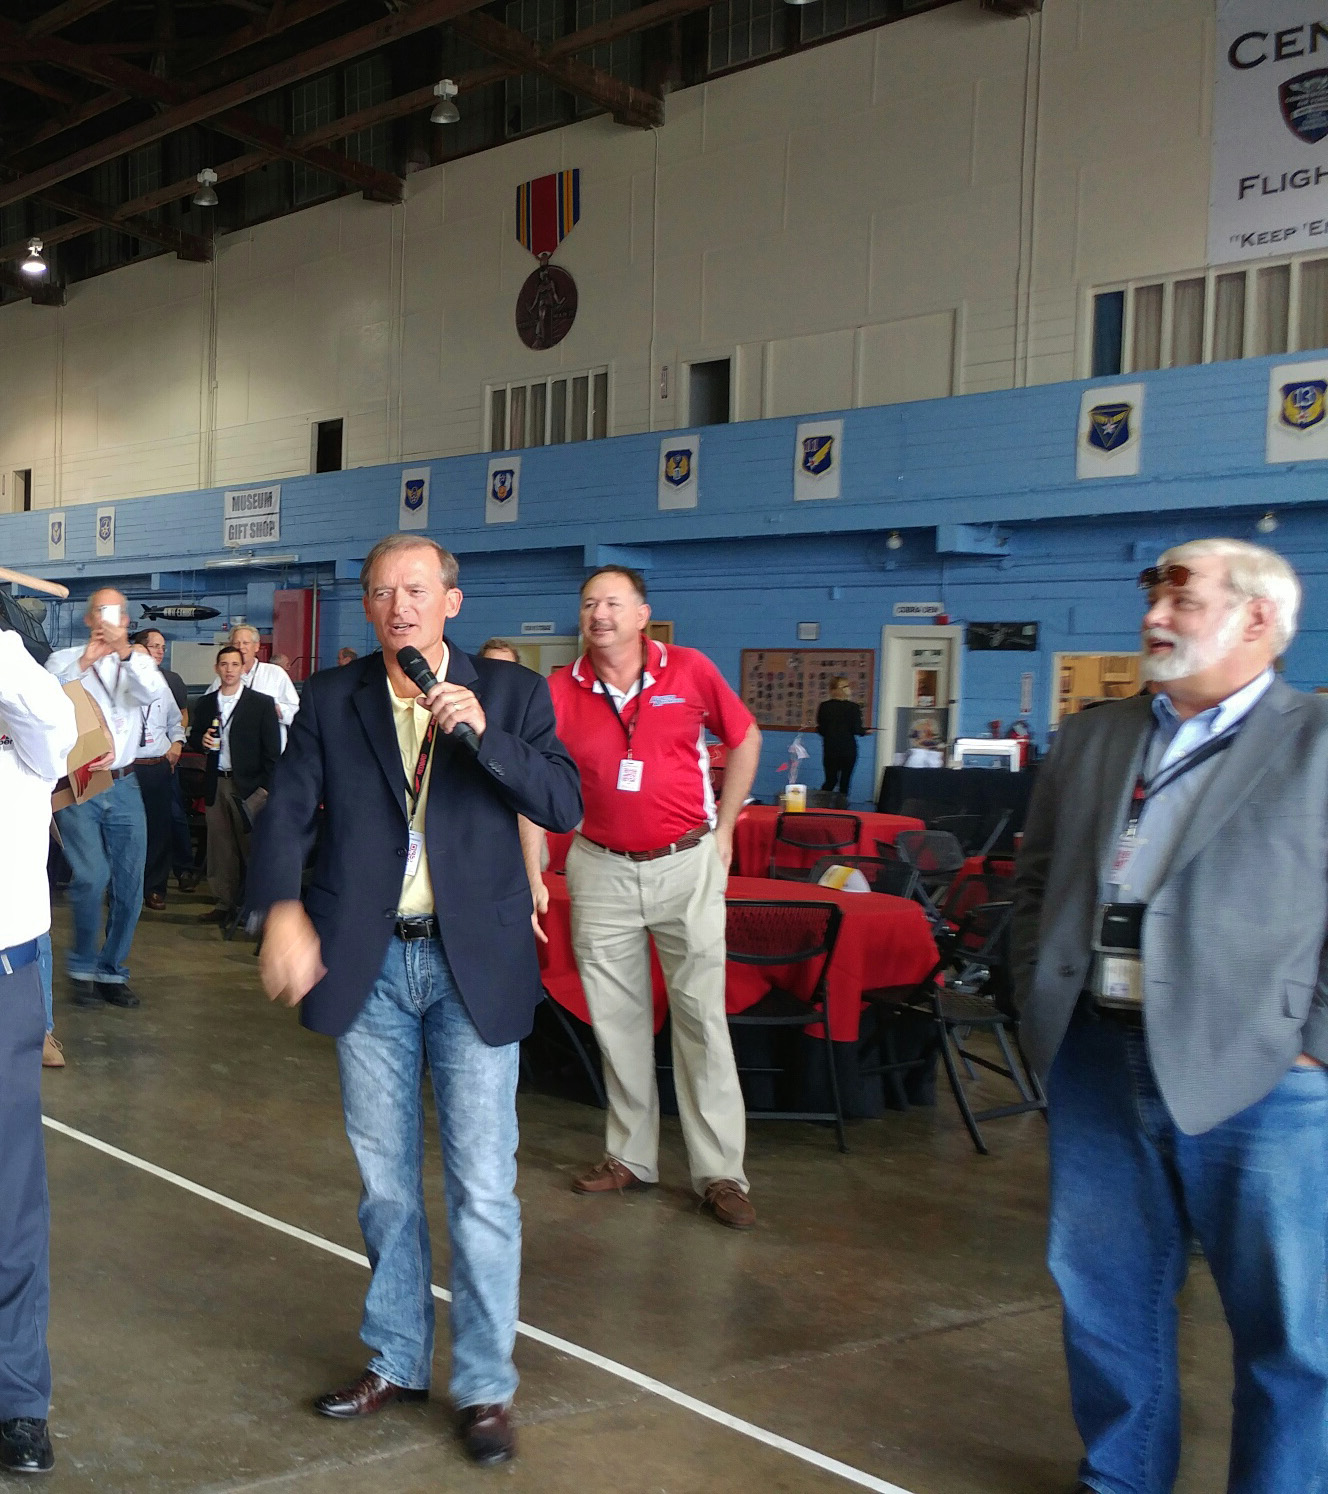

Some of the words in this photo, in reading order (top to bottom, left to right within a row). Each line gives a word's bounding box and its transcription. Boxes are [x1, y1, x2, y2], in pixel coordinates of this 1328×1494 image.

[1295, 386, 1316, 407] 13
[232, 491, 273, 511] MUSEUM
[228, 523, 249, 541] GIFT
[249, 520, 275, 539] SHOP
